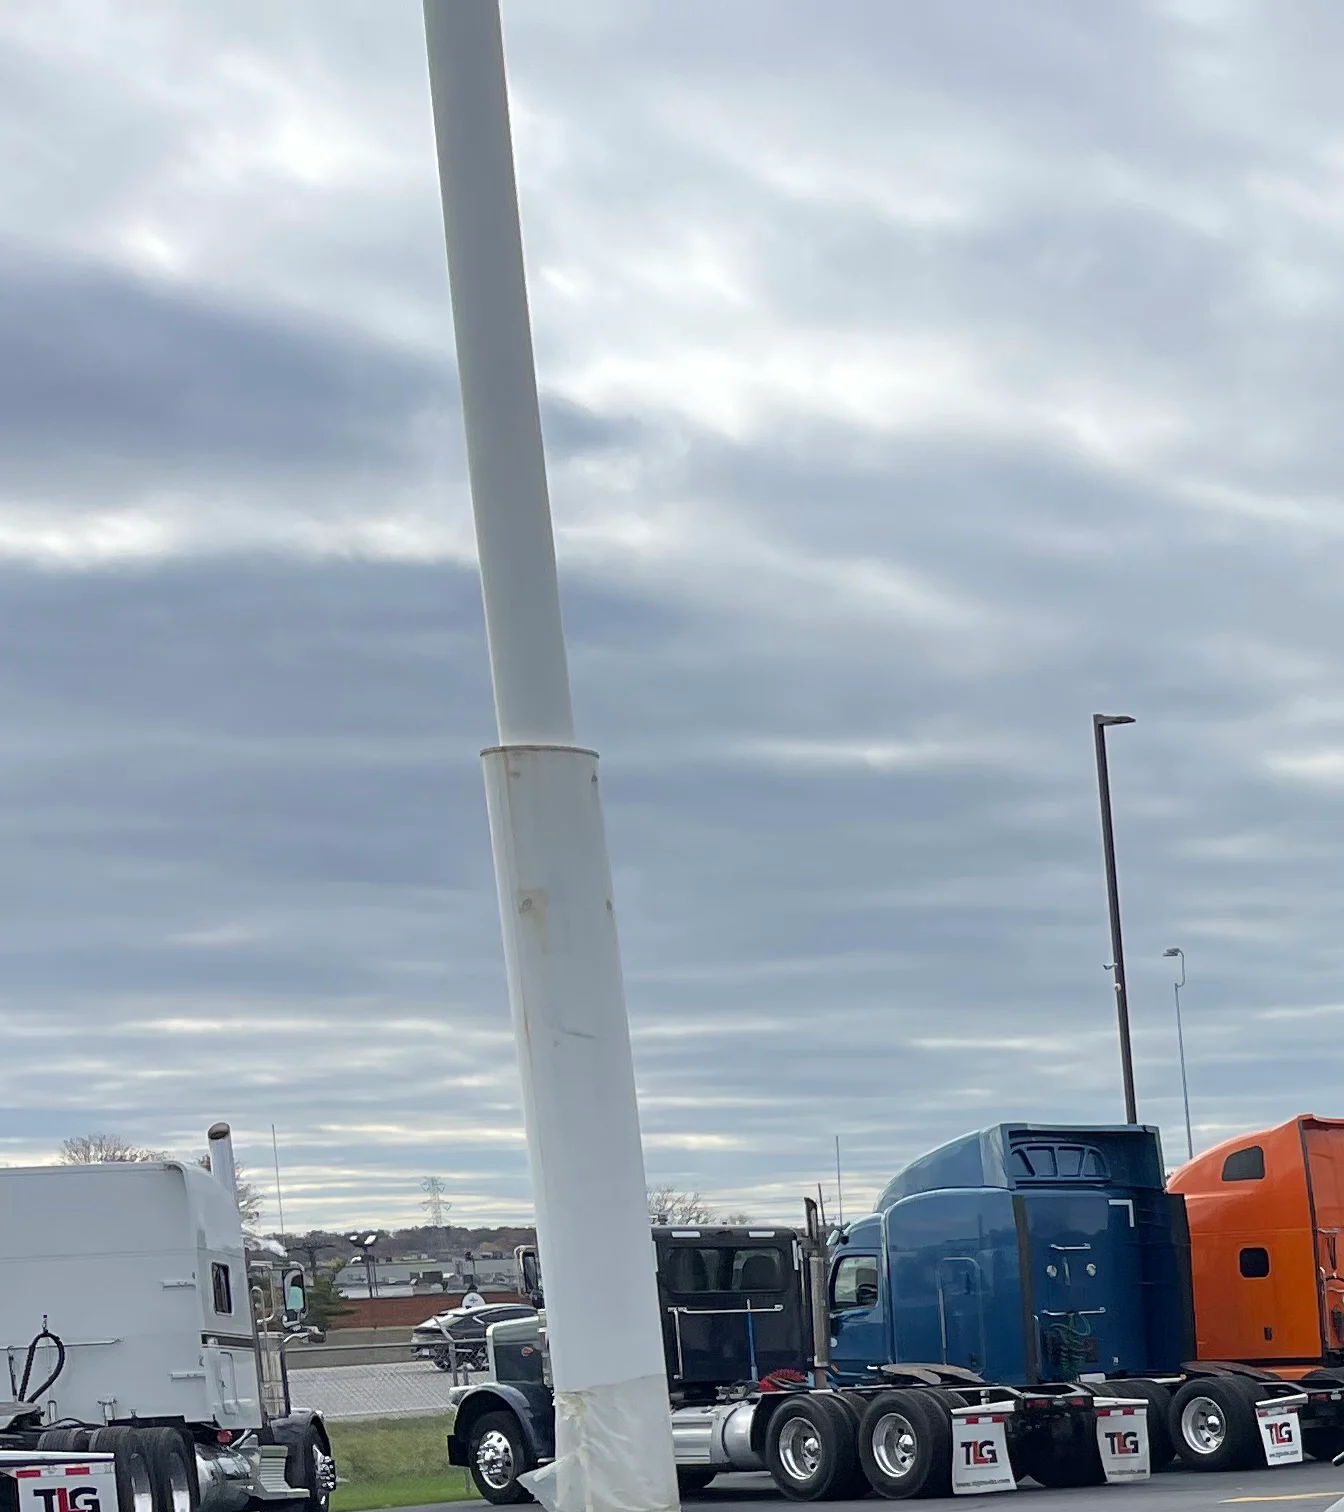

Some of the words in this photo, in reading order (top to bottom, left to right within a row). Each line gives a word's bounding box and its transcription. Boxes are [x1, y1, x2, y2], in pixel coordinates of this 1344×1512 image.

[1104, 1432, 1139, 1454] TLG
[1265, 1421, 1293, 1445] TLG
[960, 1440, 998, 1465] TLG
